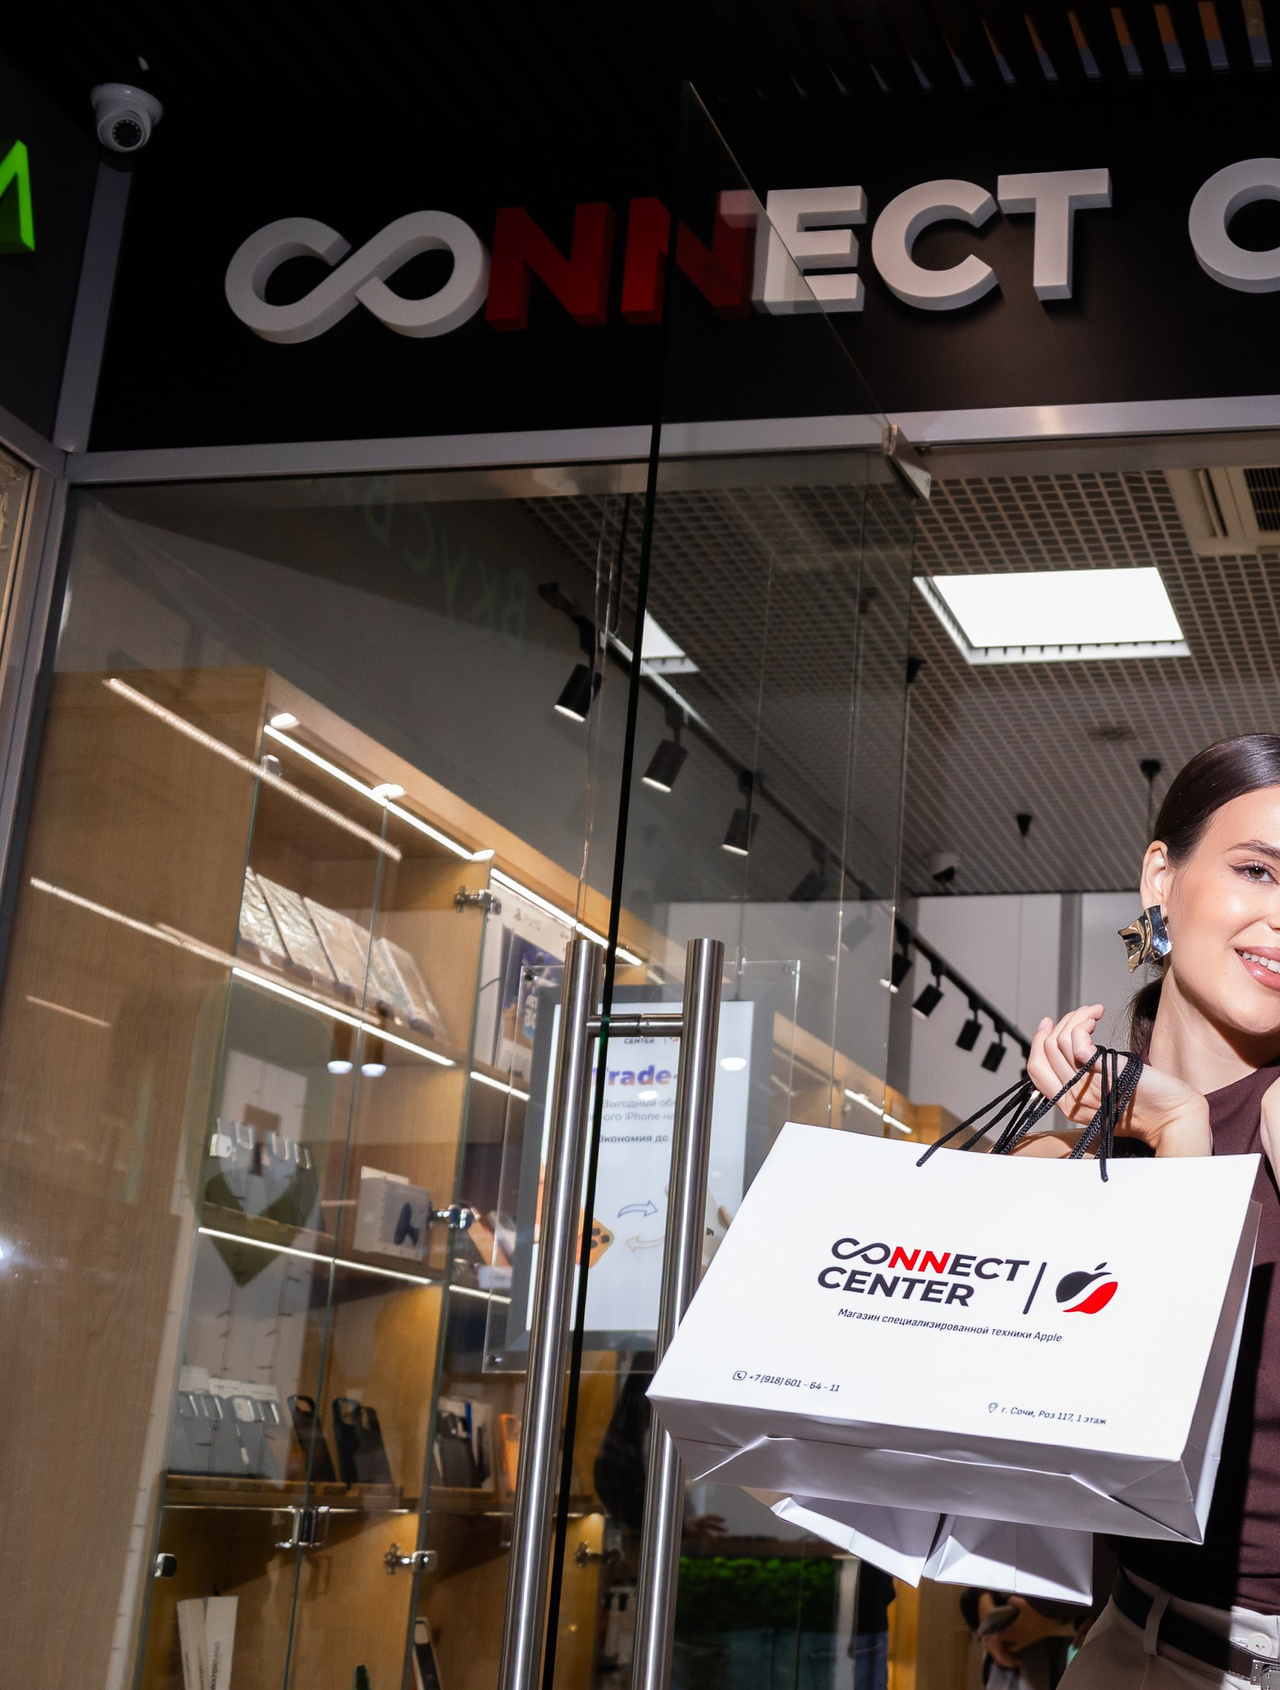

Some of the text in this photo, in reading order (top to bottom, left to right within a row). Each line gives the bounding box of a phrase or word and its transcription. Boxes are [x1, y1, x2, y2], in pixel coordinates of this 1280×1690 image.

[225, 167, 1111, 344] CONNECT
[625, 1111, 660, 1121] iPhone
[831, 1237, 1030, 1281] CONNECT
[817, 1266, 975, 1307] CENTER
[838, 1308, 1062, 1343] Магазин специализированной техники Apple
[761, 1374, 784, 1386] (918)
[785, 1378, 802, 1388] 601
[809, 1381, 822, 1391] 64
[829, 1384, 840, 1393] 11
[1010, 1407, 1035, 1418] Сочи,
[1038, 1409, 1055, 1420] Роз
[1058, 1412, 1074, 1423] 117,
[1076, 1414, 1082, 1422] 1
[1083, 1416, 1107, 1425] этаж
